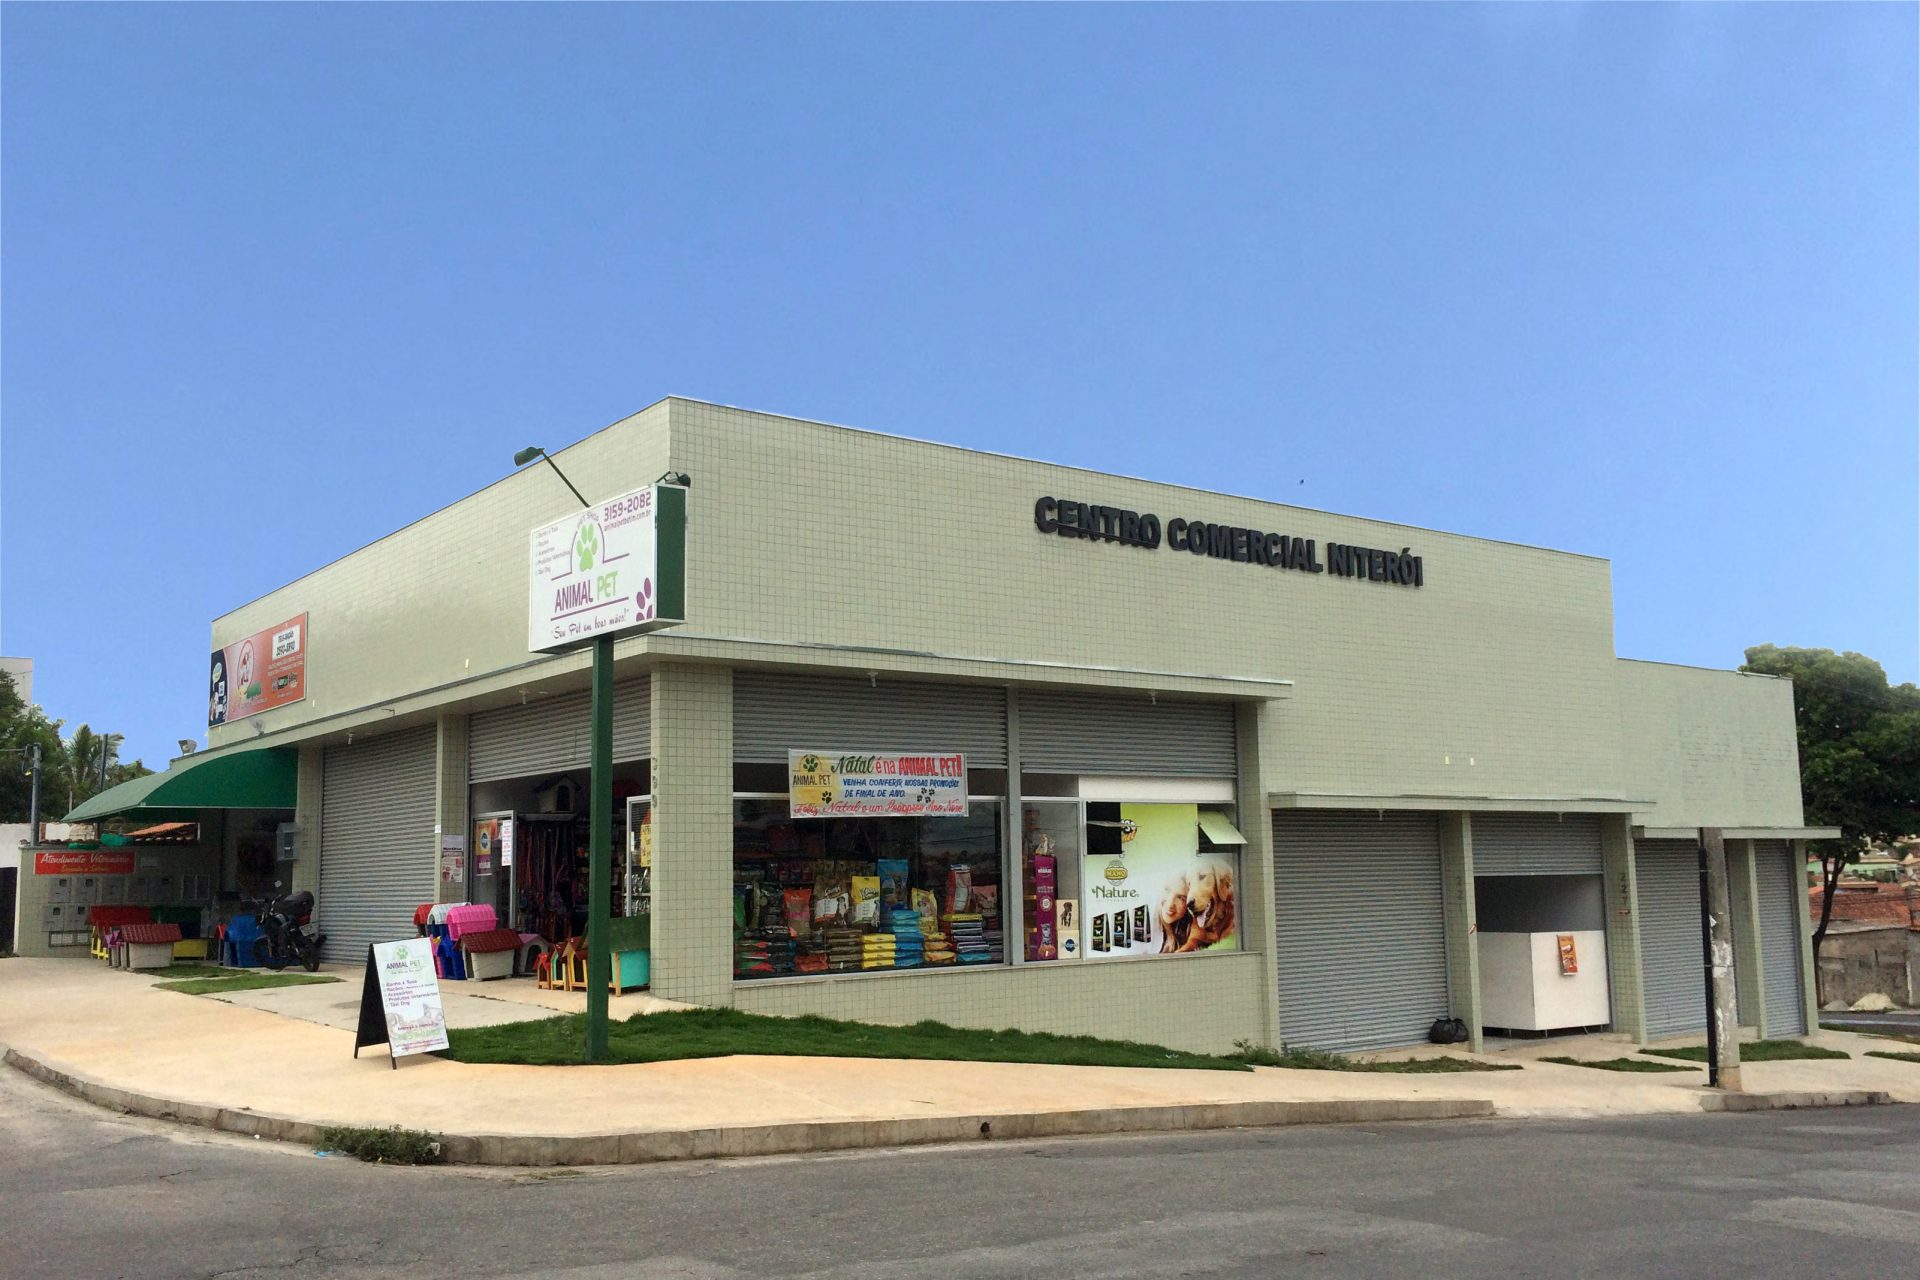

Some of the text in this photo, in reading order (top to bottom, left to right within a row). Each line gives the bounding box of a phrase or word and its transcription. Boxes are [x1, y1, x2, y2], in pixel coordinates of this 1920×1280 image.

[604, 491, 652, 522] 3159-2082
[1035, 496, 1424, 587] CENTRO COMERCIAL NITERÓI
[554, 570, 618, 613] ANIMAL PET
[831, 755, 876, 774] Natal
[875, 755, 881, 774] é
[883, 759, 896, 774] na
[898, 757, 939, 776] ANIMAL
[792, 774, 831, 786] ANIMAL PET
[842, 778, 867, 786] VENHA
[868, 778, 902, 788] CONFERIR
[904, 779, 928, 787] NOSSAS
[844, 789, 854, 798] DE
[855, 789, 876, 798] FINAL
[876, 789, 886, 798] DE
[823, 800, 861, 813] Natal
[869, 804, 883, 812] um
[40, 852, 86, 864] Atendimento
[1095, 885, 1137, 899] Nature
[386, 960, 409, 970] ANIMAL
